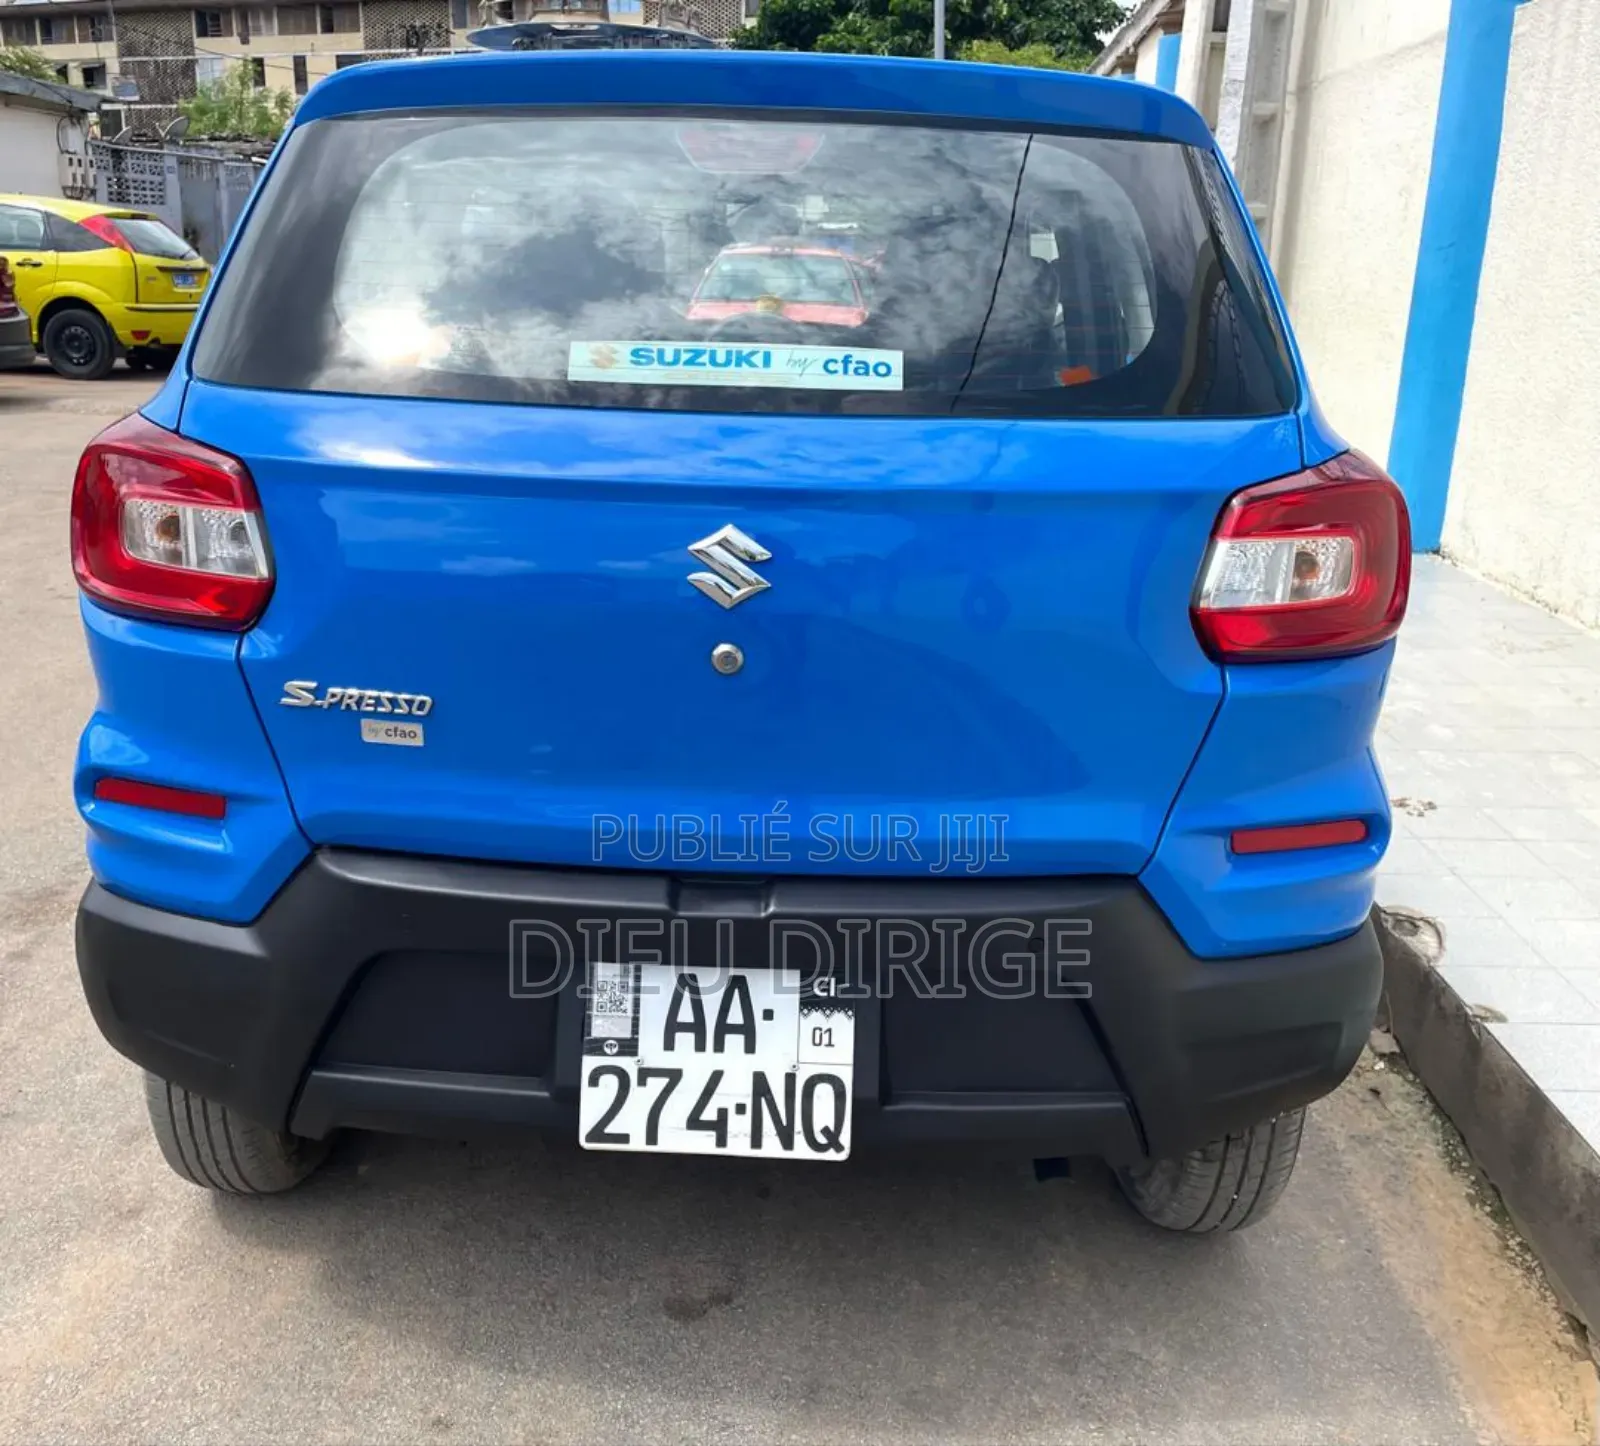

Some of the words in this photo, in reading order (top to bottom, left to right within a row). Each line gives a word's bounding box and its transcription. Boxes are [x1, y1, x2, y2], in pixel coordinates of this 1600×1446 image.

[629, 346, 772, 369] SUZUKI
[822, 353, 893, 378] cfao
[384, 726, 418, 740] cfao
[811, 1026, 835, 1048] 01
